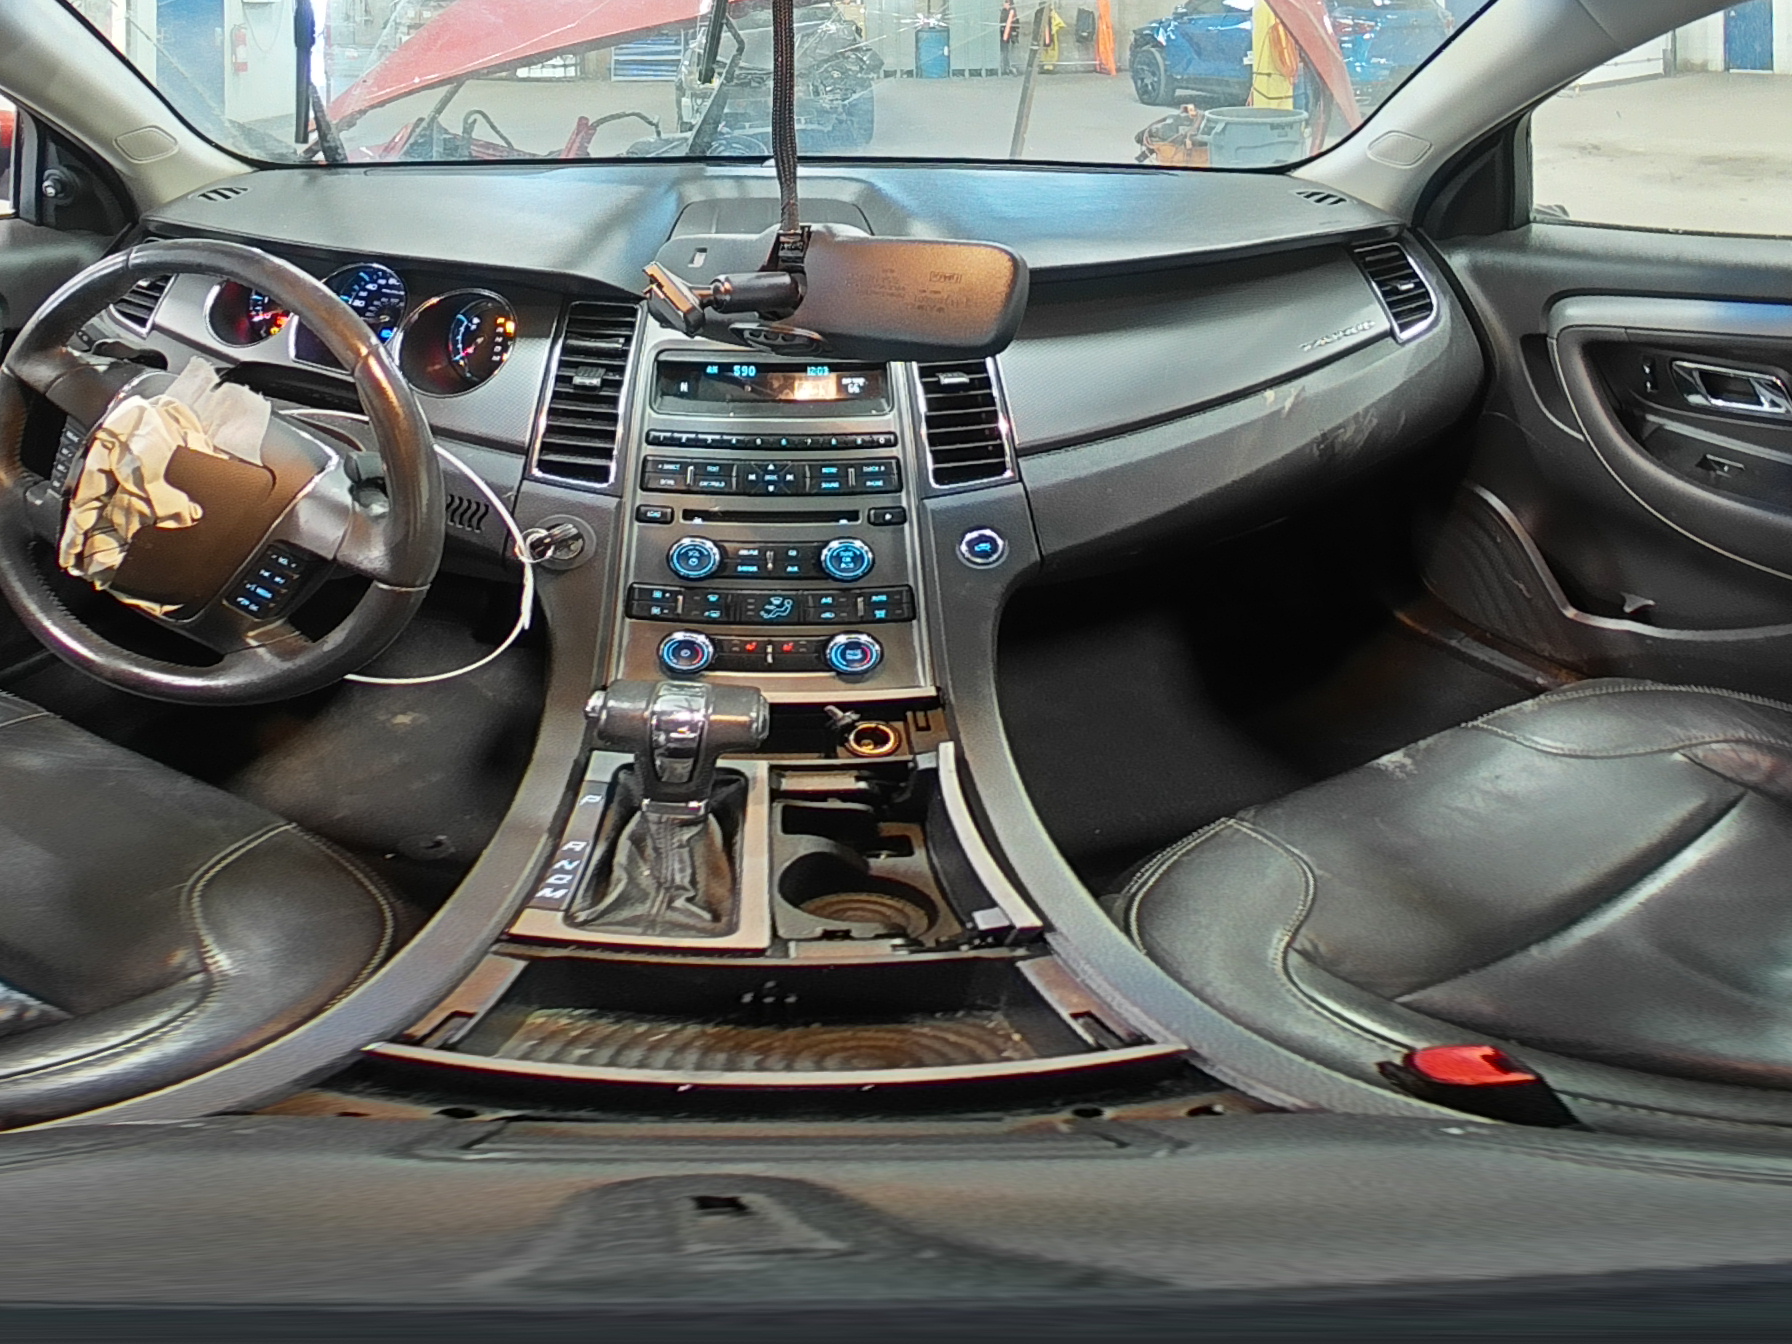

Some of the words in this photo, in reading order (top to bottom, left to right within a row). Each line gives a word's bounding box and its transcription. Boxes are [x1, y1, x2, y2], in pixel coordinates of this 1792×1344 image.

[733, 365, 756, 376] 590
[579, 794, 602, 806] P
[553, 859, 580, 871] N
[535, 888, 569, 899] M
